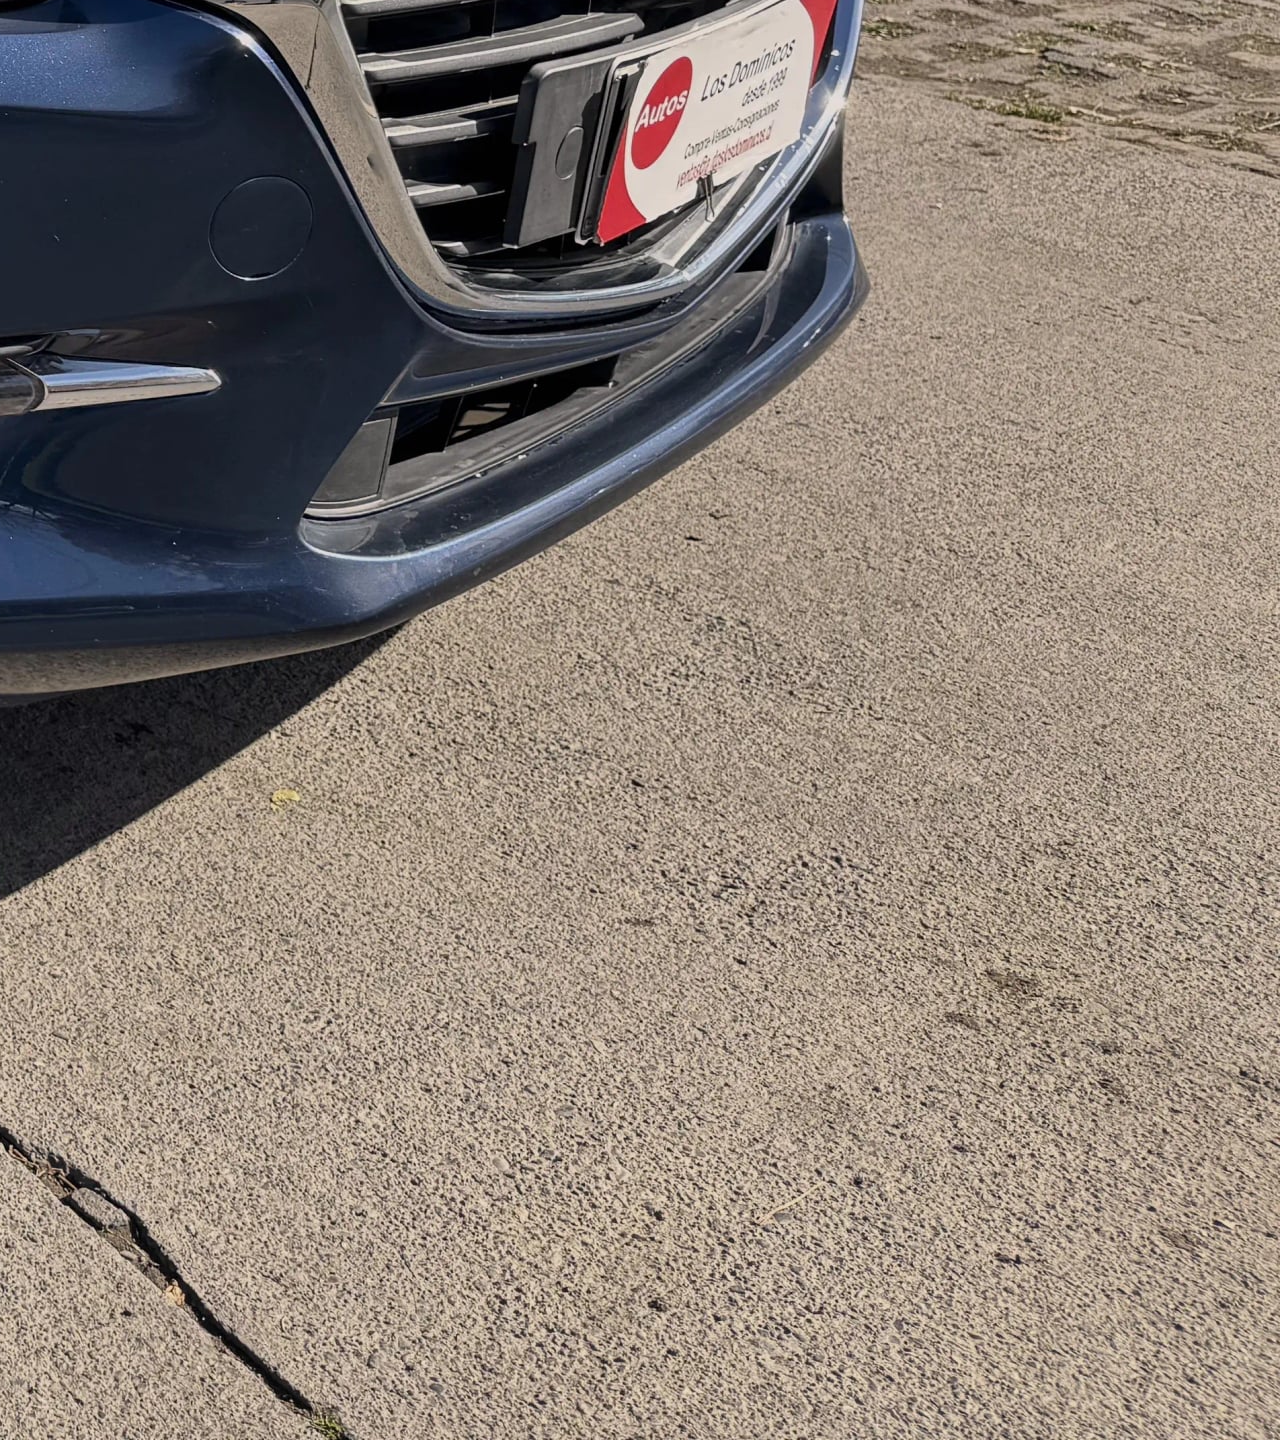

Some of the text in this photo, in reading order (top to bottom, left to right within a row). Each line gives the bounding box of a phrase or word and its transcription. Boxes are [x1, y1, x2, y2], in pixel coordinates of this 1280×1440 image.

[700, 39, 796, 102] Los Dominicos
[634, 89, 689, 133] Autos
